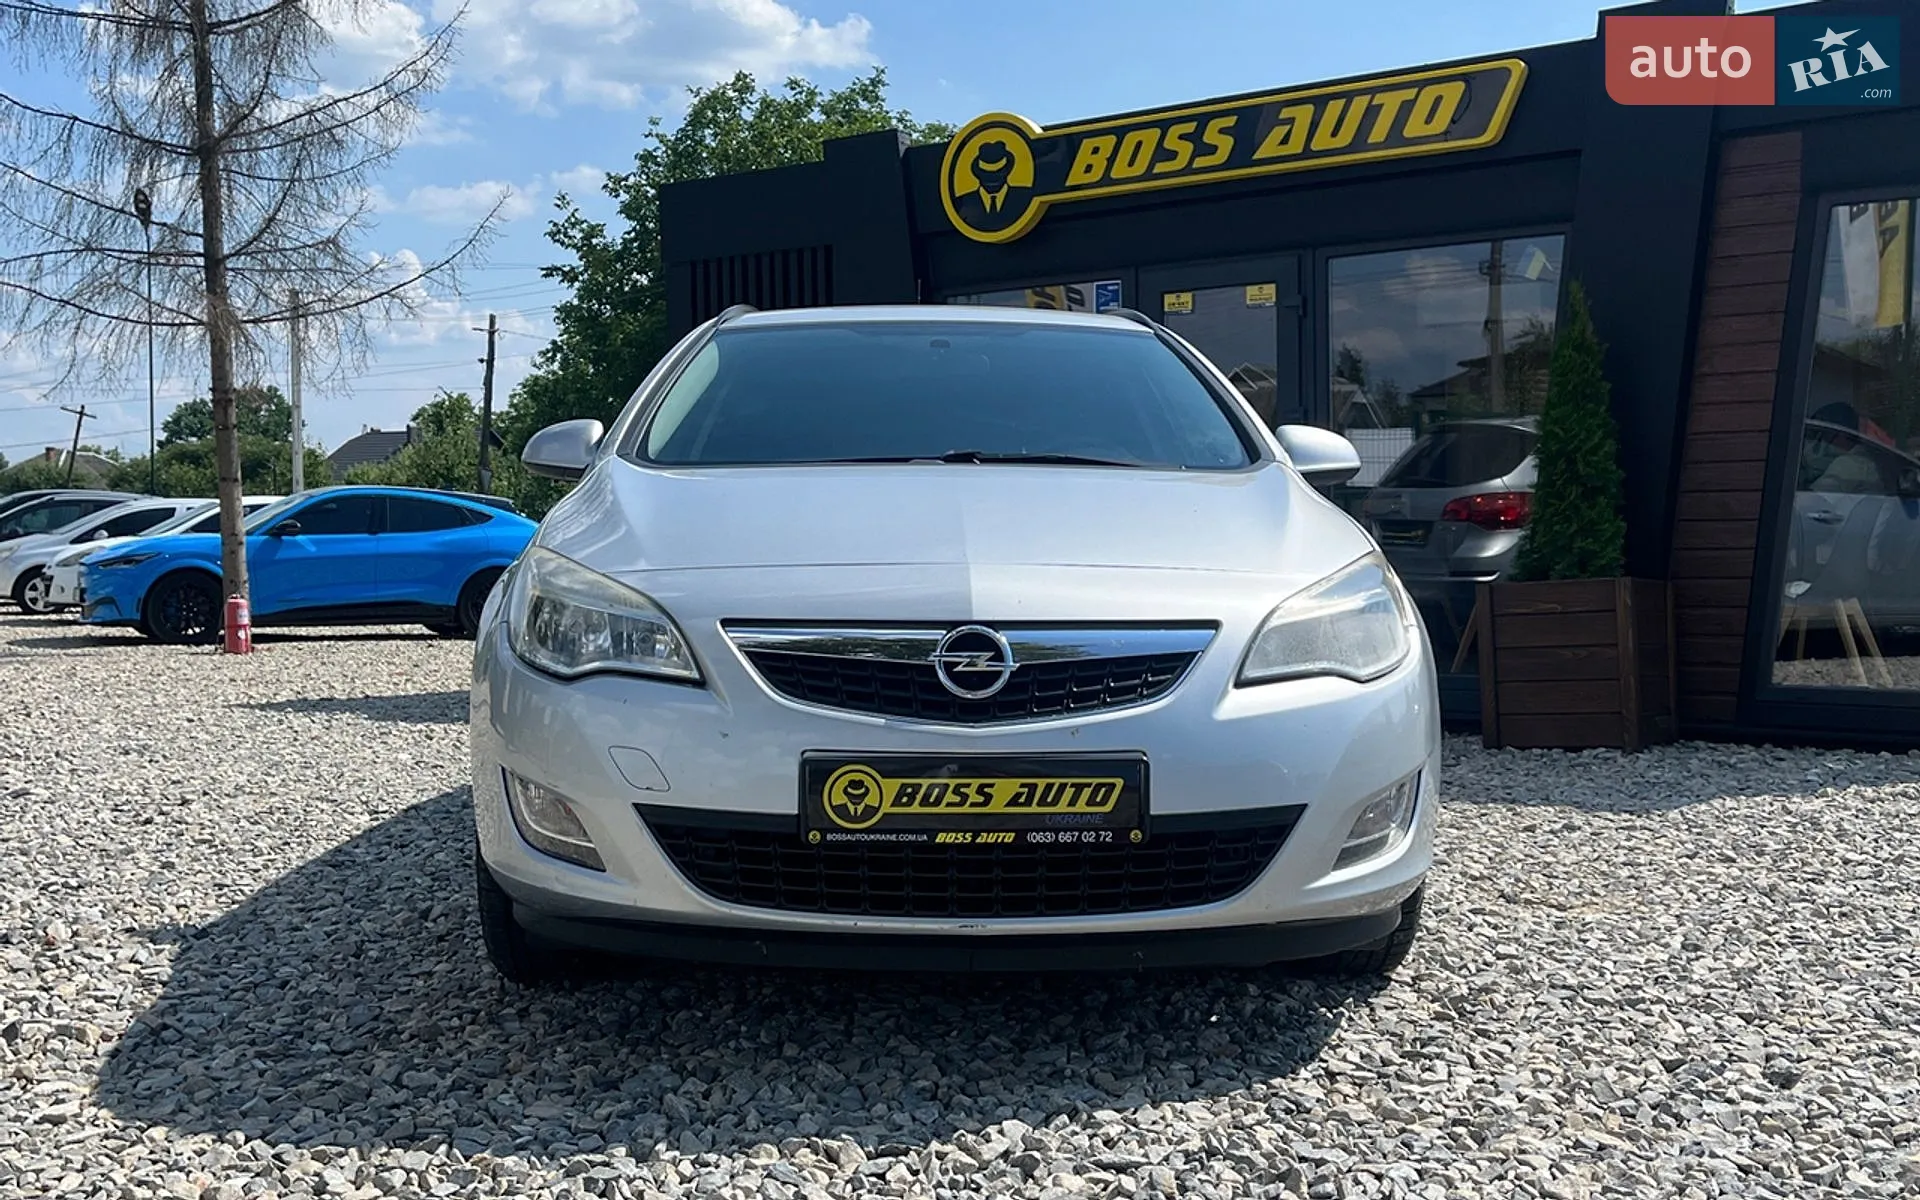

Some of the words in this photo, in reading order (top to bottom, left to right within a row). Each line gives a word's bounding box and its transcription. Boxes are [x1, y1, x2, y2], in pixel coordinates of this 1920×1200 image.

[1065, 115, 1238, 187] BOSS
[1251, 80, 1467, 160] AUTO
[889, 782, 998, 809] BOSS
[1003, 782, 1118, 808] AUTO
[1044, 814, 1105, 824] UKRAINE
[826, 833, 928, 842] BOSSAUTOUKRAINE.COM.UA
[935, 832, 973, 843] BOSS
[975, 832, 1016, 843] AUTO
[1026, 832, 1055, 843] (063)
[1058, 832, 1079, 843] 667
[1081, 832, 1096, 843] 02
[1099, 832, 1113, 843] 72
